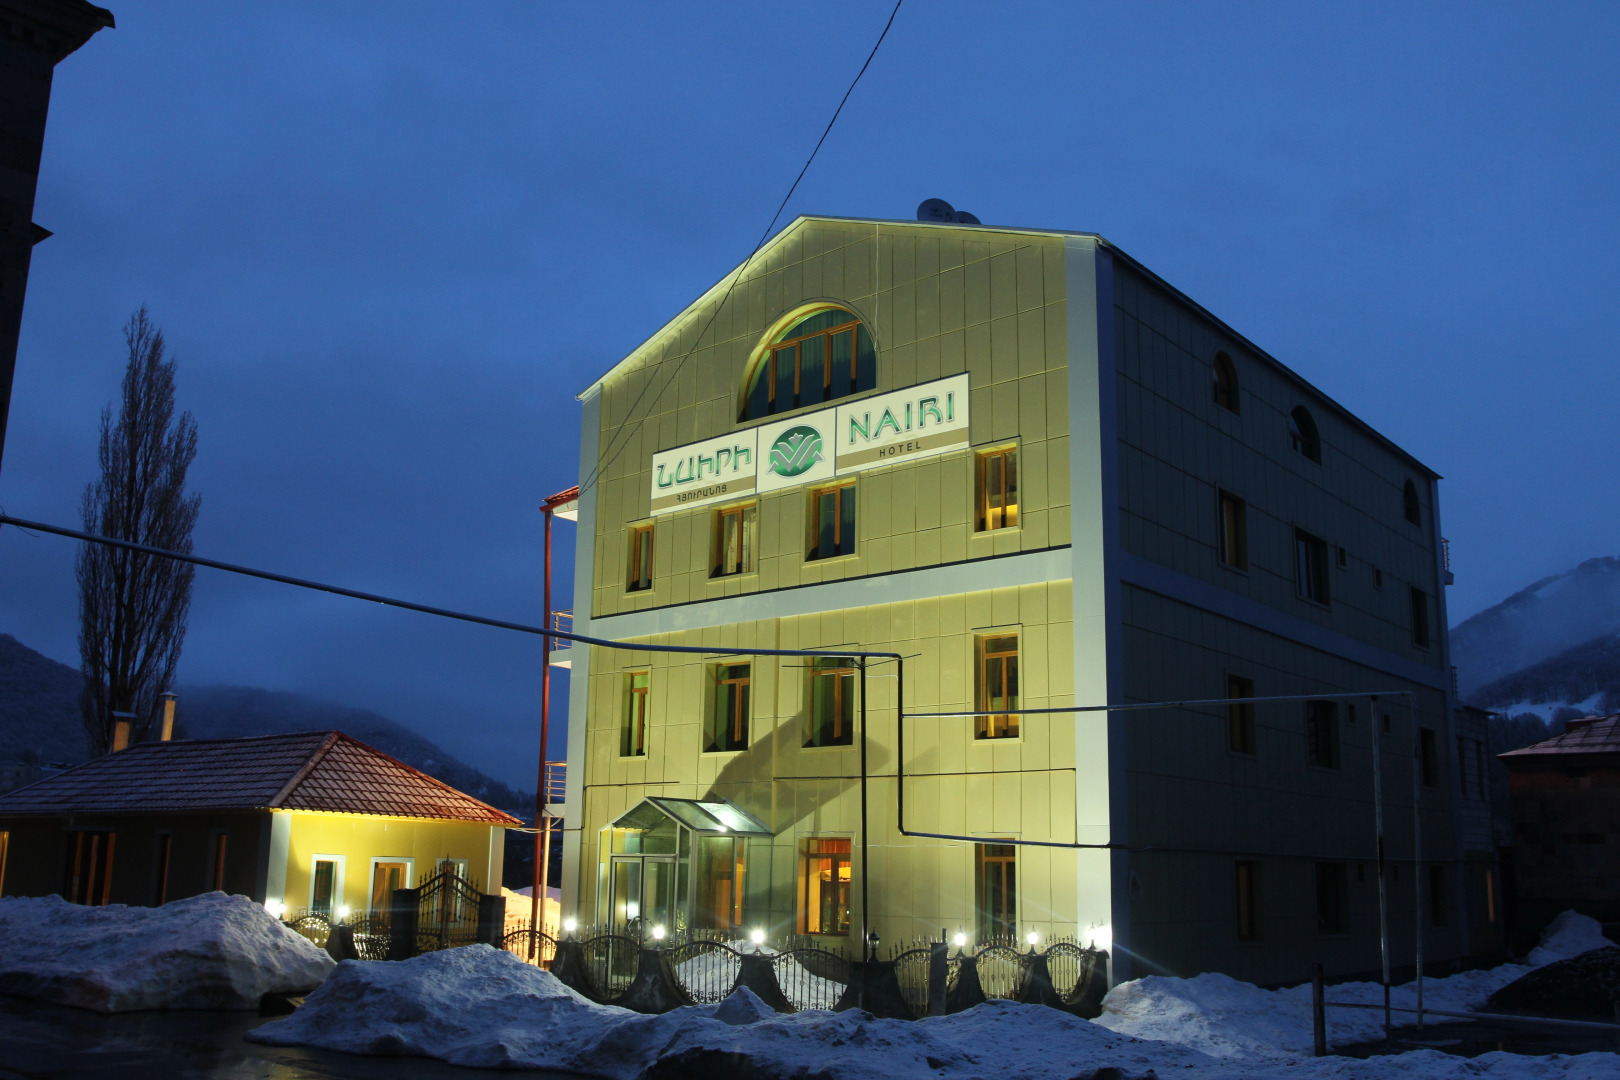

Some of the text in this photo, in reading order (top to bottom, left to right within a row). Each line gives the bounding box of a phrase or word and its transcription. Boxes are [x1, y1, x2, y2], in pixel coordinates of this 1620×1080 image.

[850, 392, 953, 443] NAIRI
[879, 441, 921, 457] HOTEL
[657, 446, 750, 488] ՆԱԻՐԻ
[677, 484, 727, 502] ՀՅՈՒՐԱՆՈՑ
